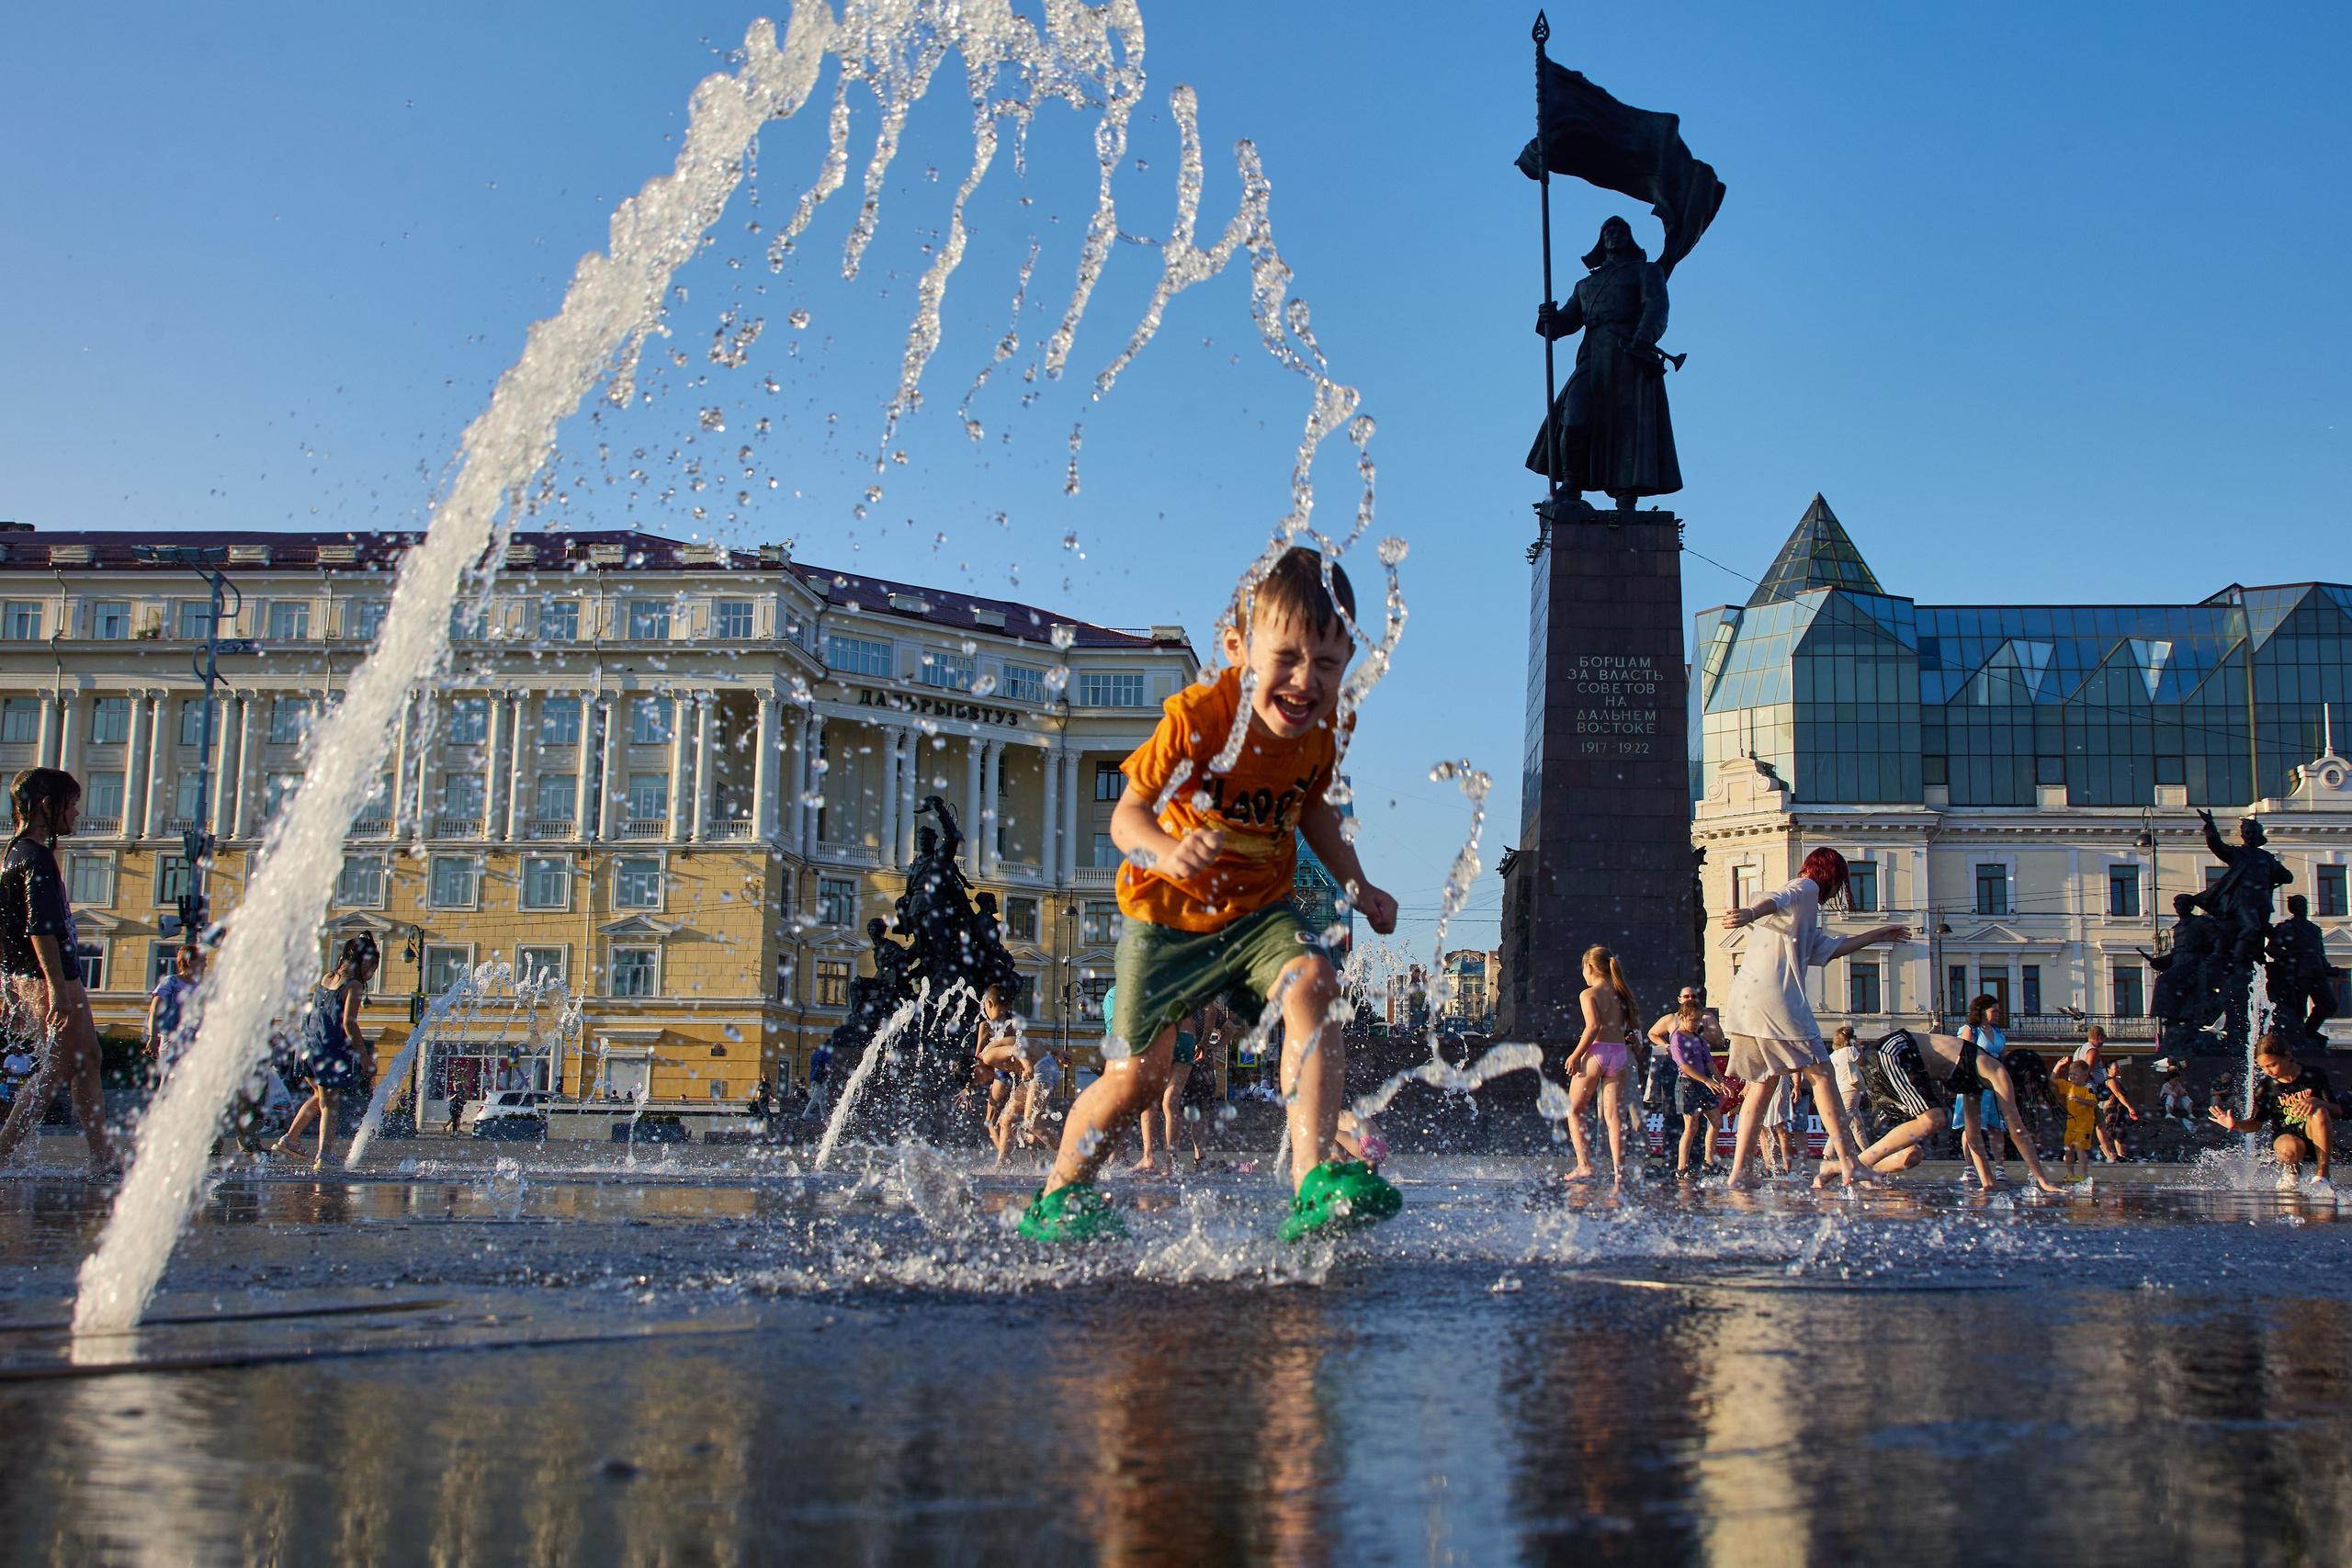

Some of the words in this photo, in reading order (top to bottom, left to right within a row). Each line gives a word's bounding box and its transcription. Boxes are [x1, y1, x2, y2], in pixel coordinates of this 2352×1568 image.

[1579, 656, 1651, 668] БОРЦАМ
[1567, 669, 1589, 681] ЗА
[1599, 670, 1664, 681] ВЛАСТЬ
[1577, 682, 1656, 694] СОВЕТОВ
[1605, 696, 1627, 706] НА
[1577, 709, 1657, 721] ДАЛЬНЕМ
[1577, 722, 1656, 734] ВОСТОКЕ
